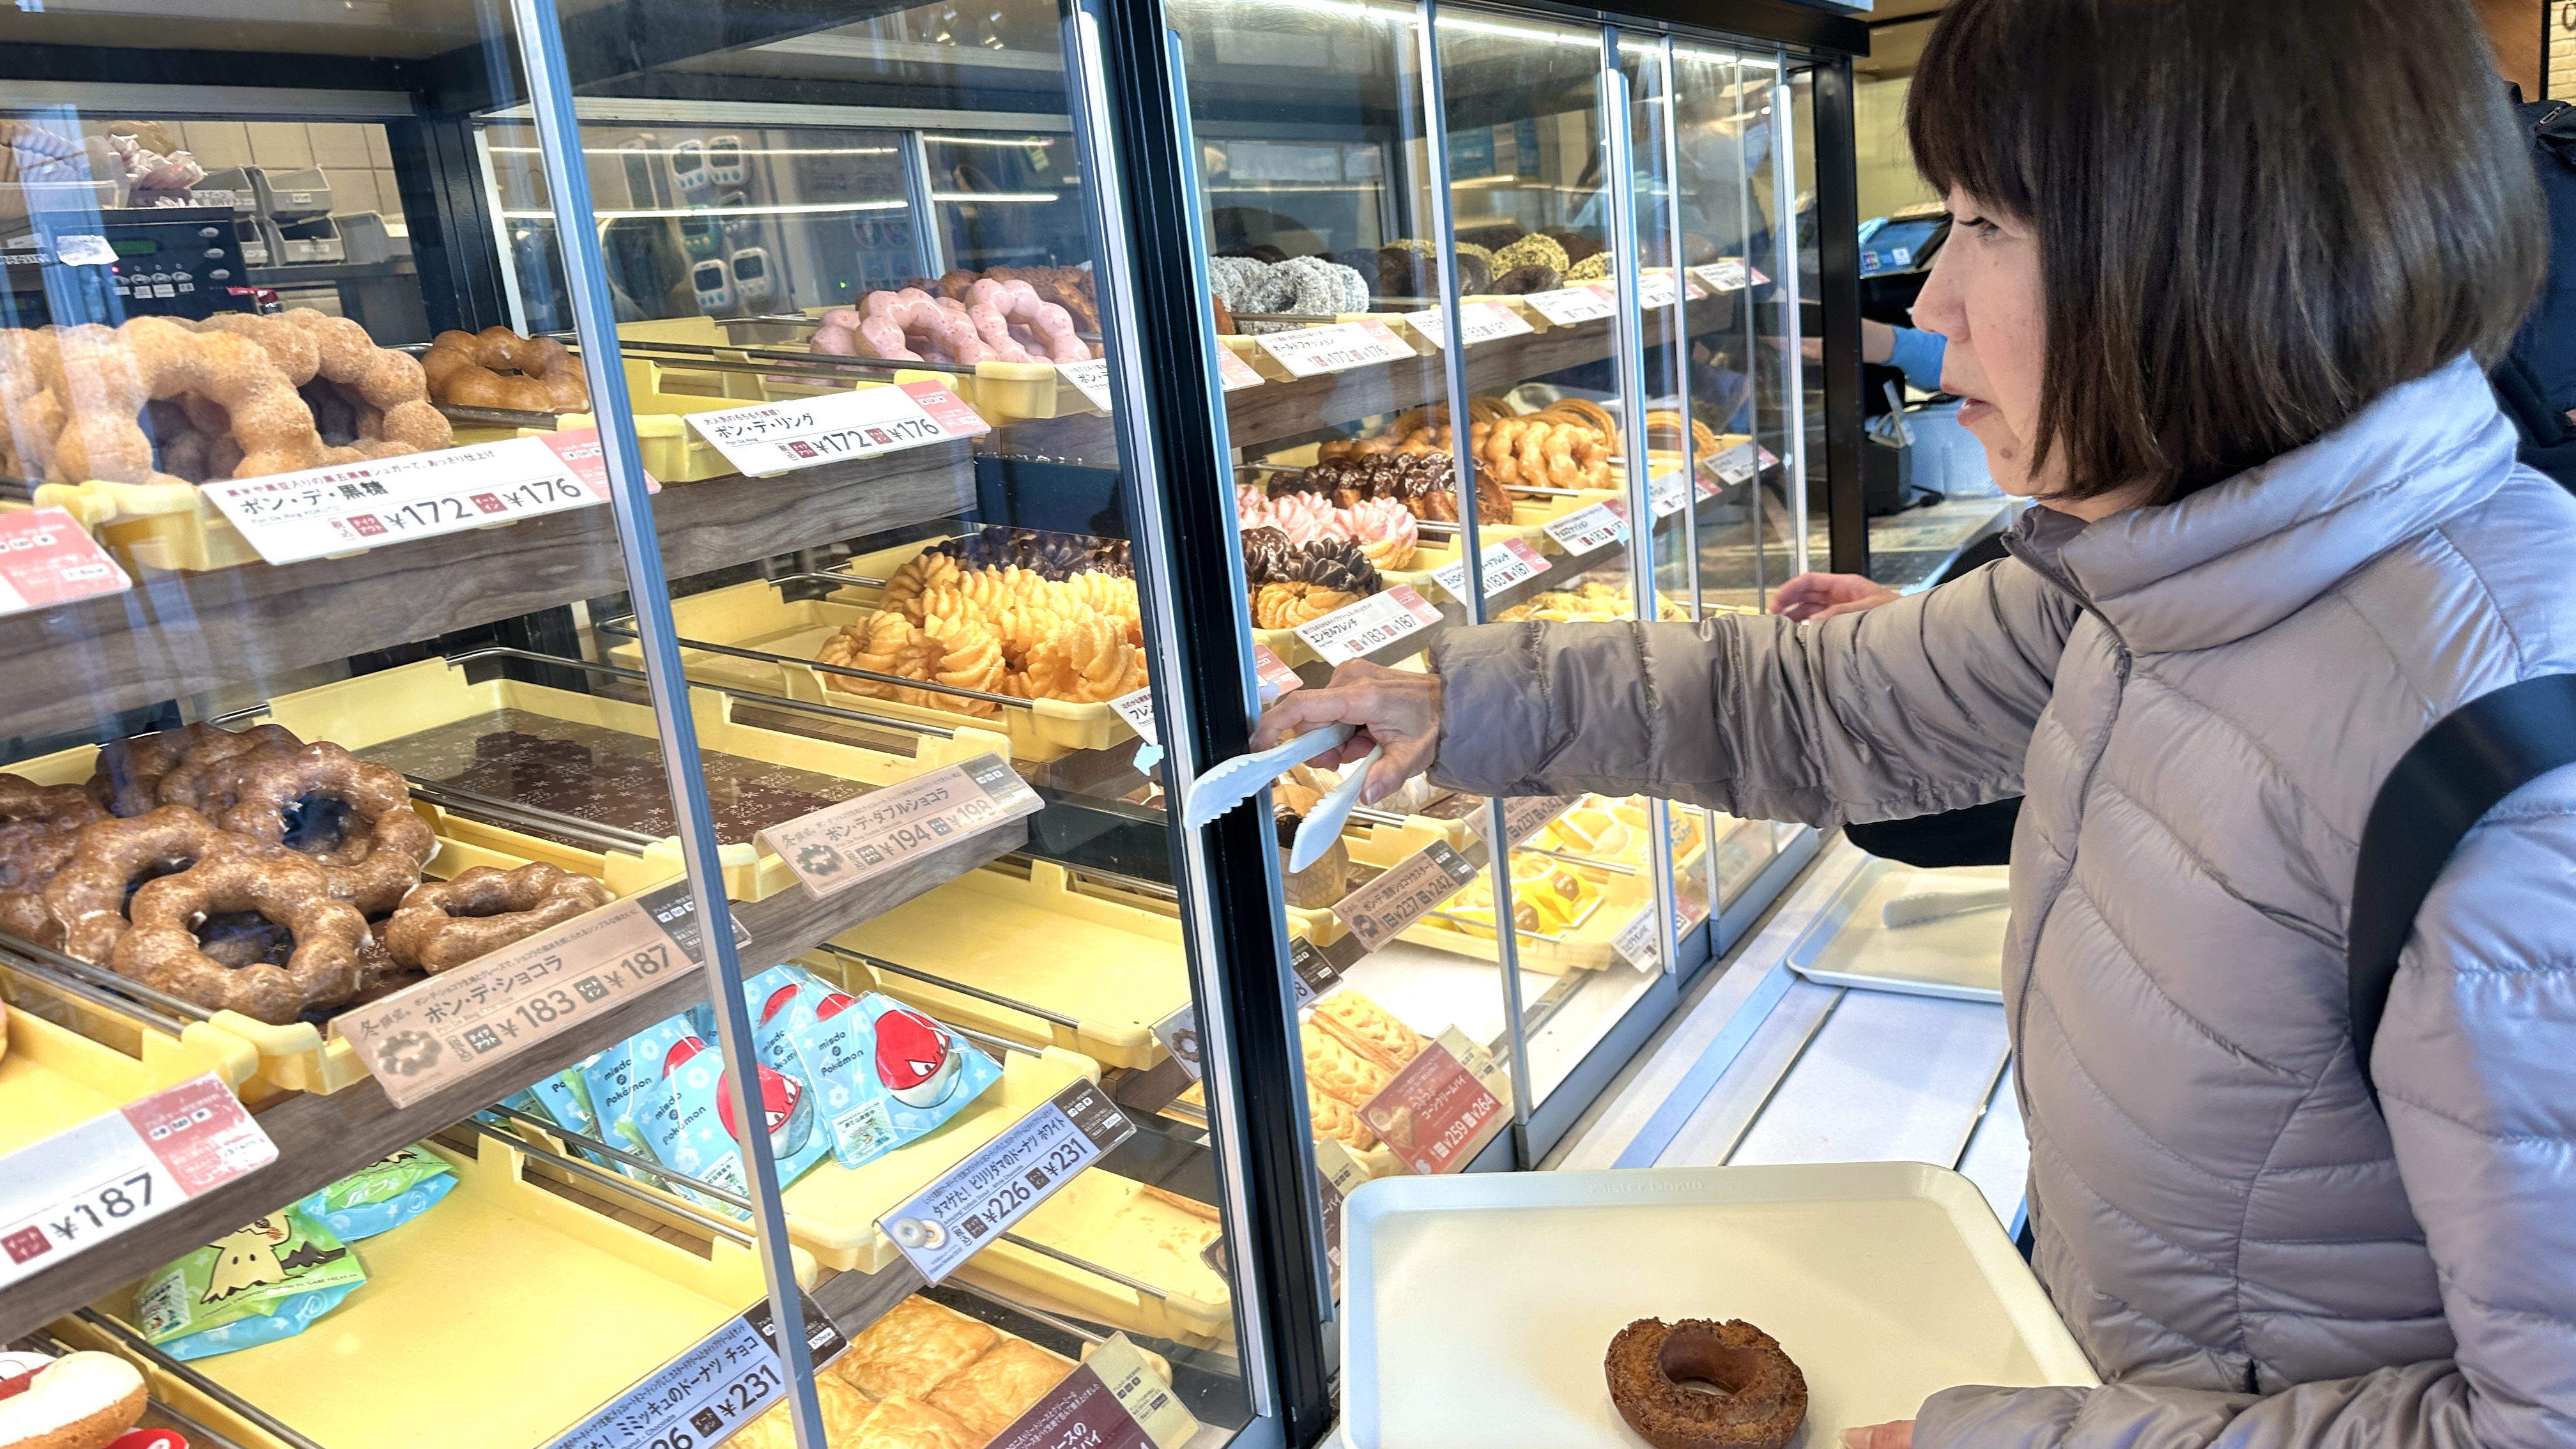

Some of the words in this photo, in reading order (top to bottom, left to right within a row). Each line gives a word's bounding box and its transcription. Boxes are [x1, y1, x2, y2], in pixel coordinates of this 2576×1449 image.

[1324, 351, 1354, 365] ¥172
[1362, 345, 1389, 358] ¥176
[714, 413, 813, 438] ポン・デ・リング
[811, 431, 872, 454] ¥172
[886, 418, 939, 441] ¥176
[241, 480, 388, 514] ポン・デ・黒糖
[384, 498, 473, 529] ¥172
[502, 478, 581, 507] ¥176
[1485, 576, 1507, 590] ¥183
[1510, 562, 1530, 578] ¥187
[1309, 618, 1358, 643] エンゼルフレンチ
[1359, 628, 1387, 647] ¥183
[1392, 613, 1416, 631] ¥187
[825, 787, 949, 841] ポン・デ・ダブルショコラ
[877, 824, 933, 856] ¥194
[945, 799, 995, 828] ¥198
[1390, 896, 1420, 921] ¥237
[1423, 873, 1453, 899] ¥242
[424, 954, 562, 1023] ポン・デ・ショコラ
[496, 988, 576, 1038] ¥183
[598, 944, 670, 988] ¥187
[579, 980, 599, 992] イート
[588, 988, 601, 997] イン
[466, 1027, 493, 1043] テイク
[472, 1034, 498, 1050] アウト
[818, 1032, 846, 1051] misdo
[604, 1059, 632, 1082] misdo
[821, 1050, 864, 1077] Pokémon
[606, 1077, 652, 1107] Pokémon
[655, 1092, 682, 1121] misdo
[663, 1107, 707, 1146] Pokémon
[1439, 1119, 1470, 1150] ¥259
[1467, 1091, 1496, 1121] ¥264
[932, 1186, 972, 1218] タマゲた！
[968, 1135, 1038, 1190] ビリリダマのドーナツ
[1037, 1117, 1065, 1140] ホワイト
[981, 1181, 1031, 1223] ¥226
[1043, 1137, 1088, 1176] ¥231
[50, 1172, 153, 1241] ¥187
[616, 1358, 723, 1436] ミミッキュのドーナツ
[725, 1336, 759, 1365] チョコ
[716, 1364, 781, 1418] ¥231
